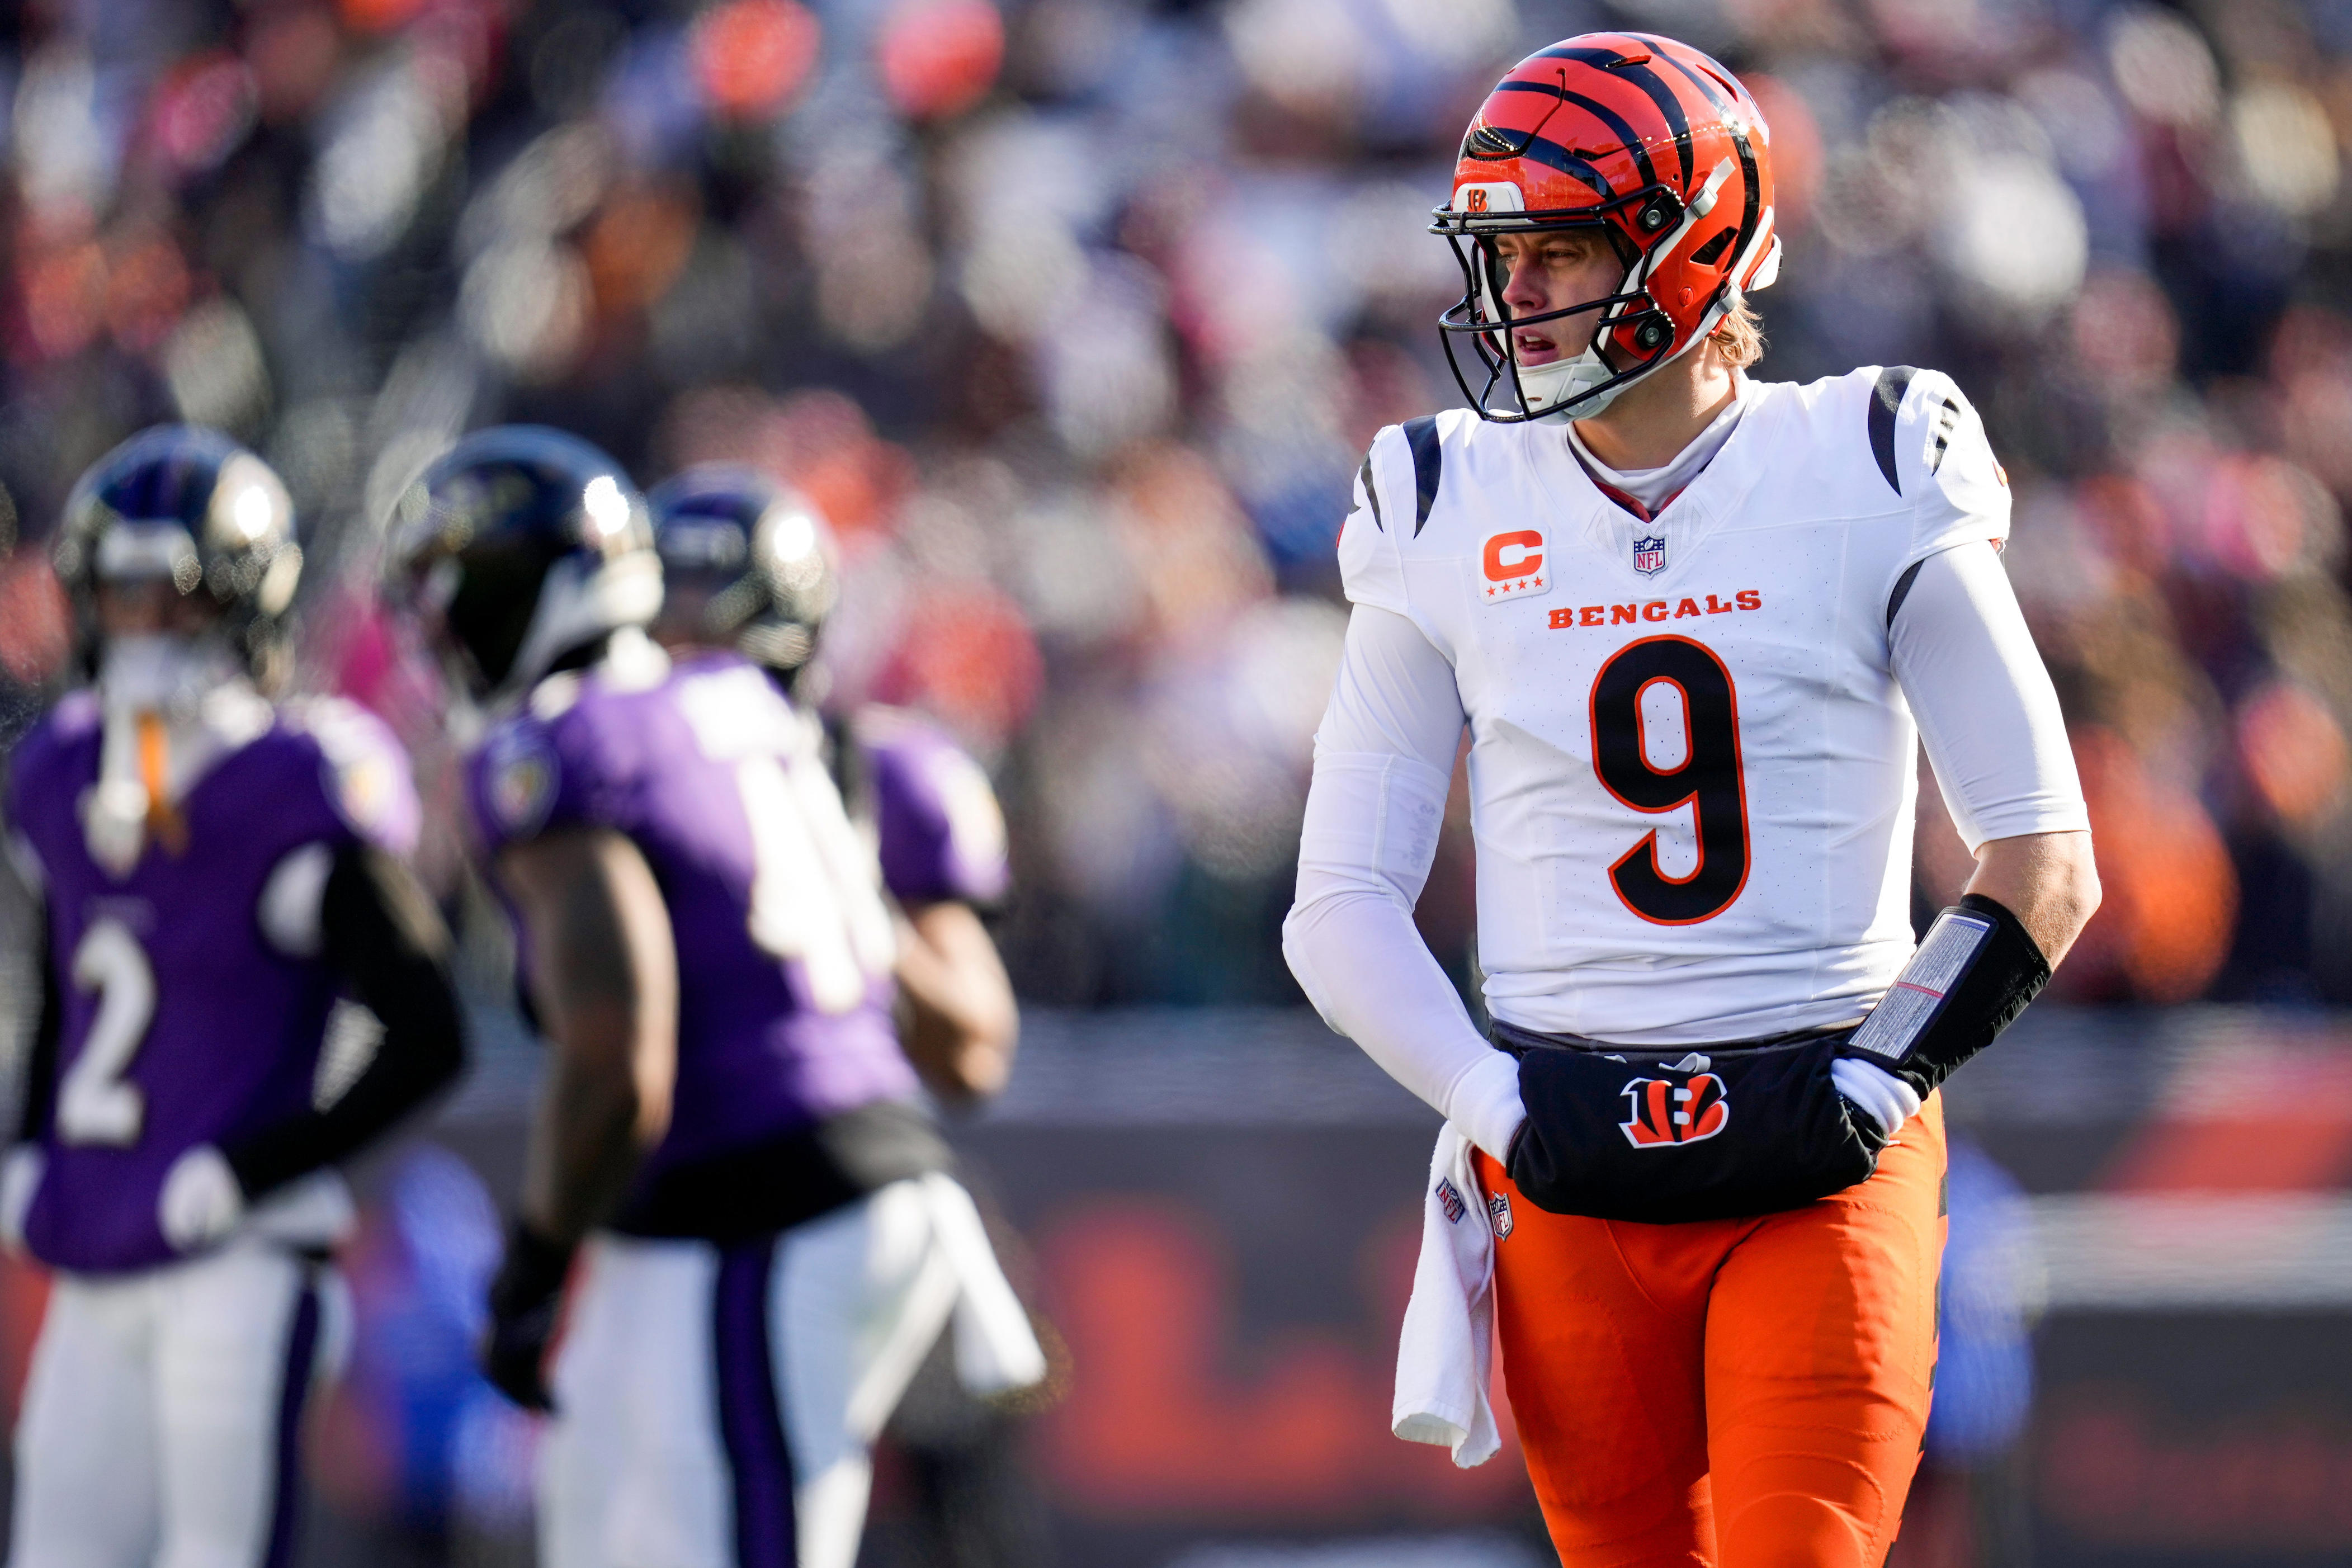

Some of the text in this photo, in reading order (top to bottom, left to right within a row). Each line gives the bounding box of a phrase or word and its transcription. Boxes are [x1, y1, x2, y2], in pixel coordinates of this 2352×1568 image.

[1484, 530, 1543, 582] C
[1637, 551, 1663, 570] NFL
[1548, 590, 1762, 630] BENGALS
[1589, 634, 1751, 926] 9
[58, 918, 159, 1148] 2
[1439, 1186, 1458, 1222] NFL
[1493, 1212, 1508, 1232] NFL
